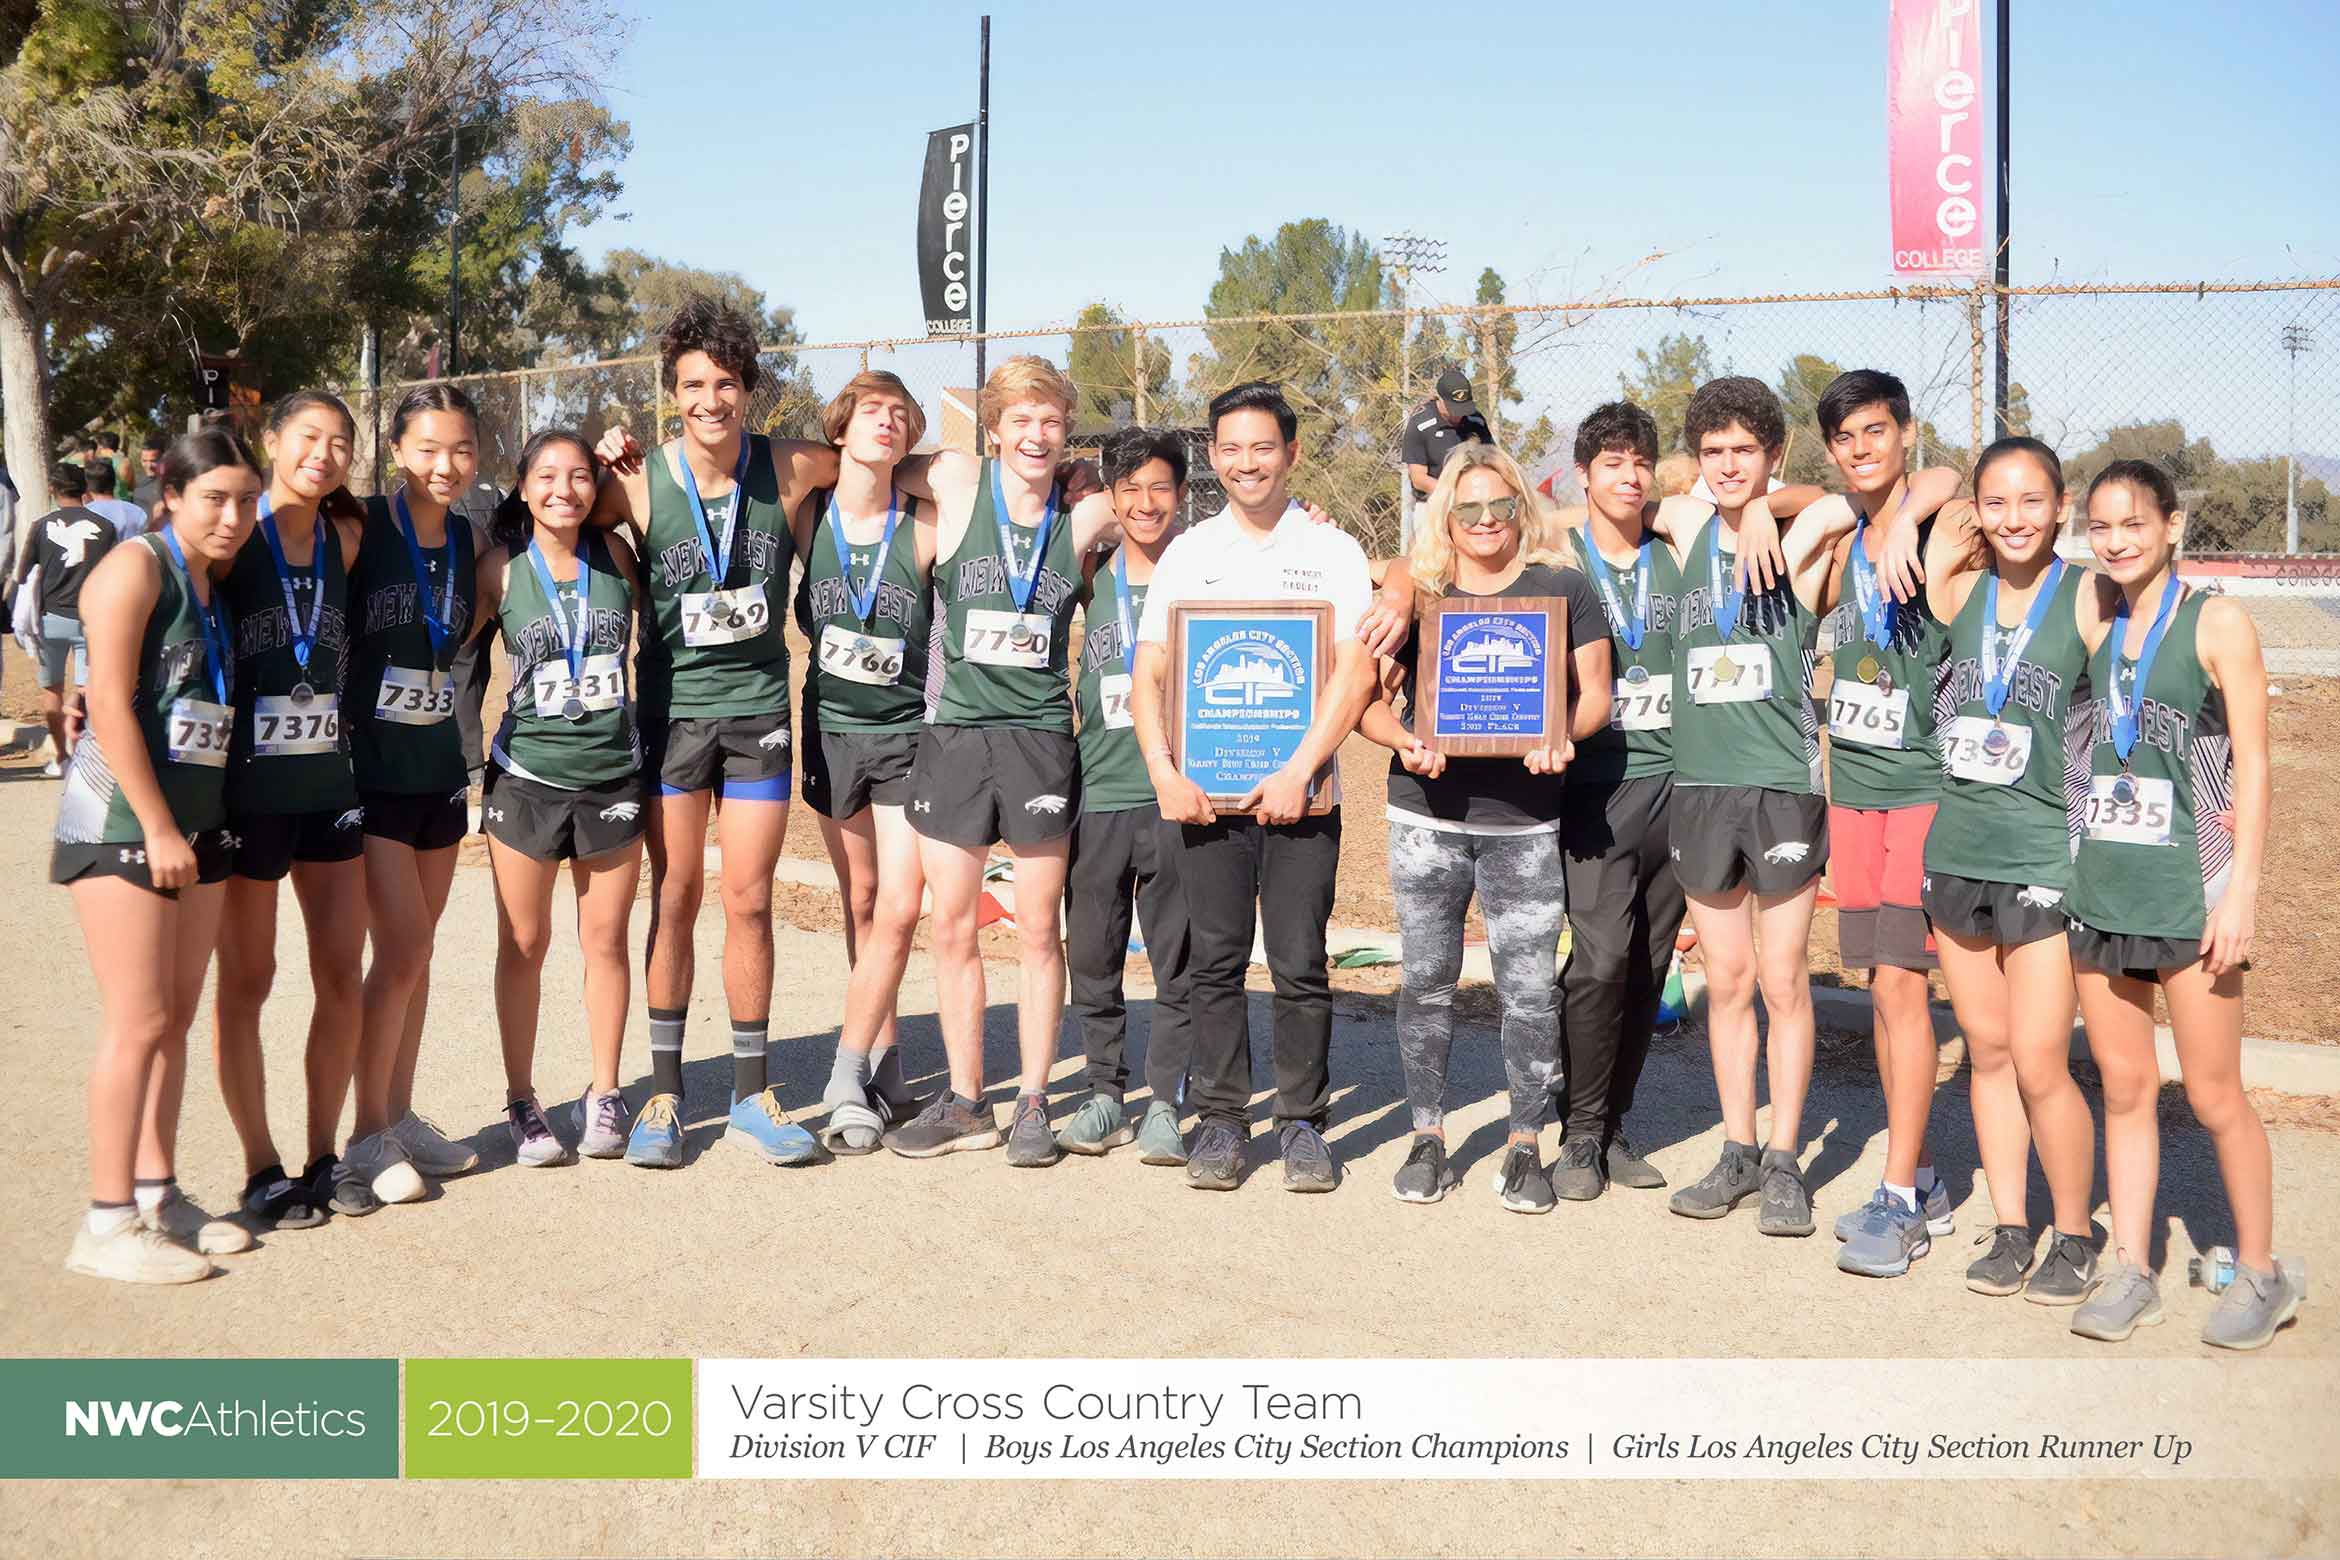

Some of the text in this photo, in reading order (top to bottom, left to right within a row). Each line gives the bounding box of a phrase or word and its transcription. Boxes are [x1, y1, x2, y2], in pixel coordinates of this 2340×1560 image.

[1895, 248, 1983, 269] COLLEGE
[927, 318, 971, 333] COLLEGE
[1452, 655, 1533, 673] CIF
[383, 685, 453, 713] 7333
[1204, 682, 1294, 705] CIF
[259, 714, 337, 740] 7376
[1833, 700, 1901, 732] 7765
[2090, 798, 2166, 827] 7335
